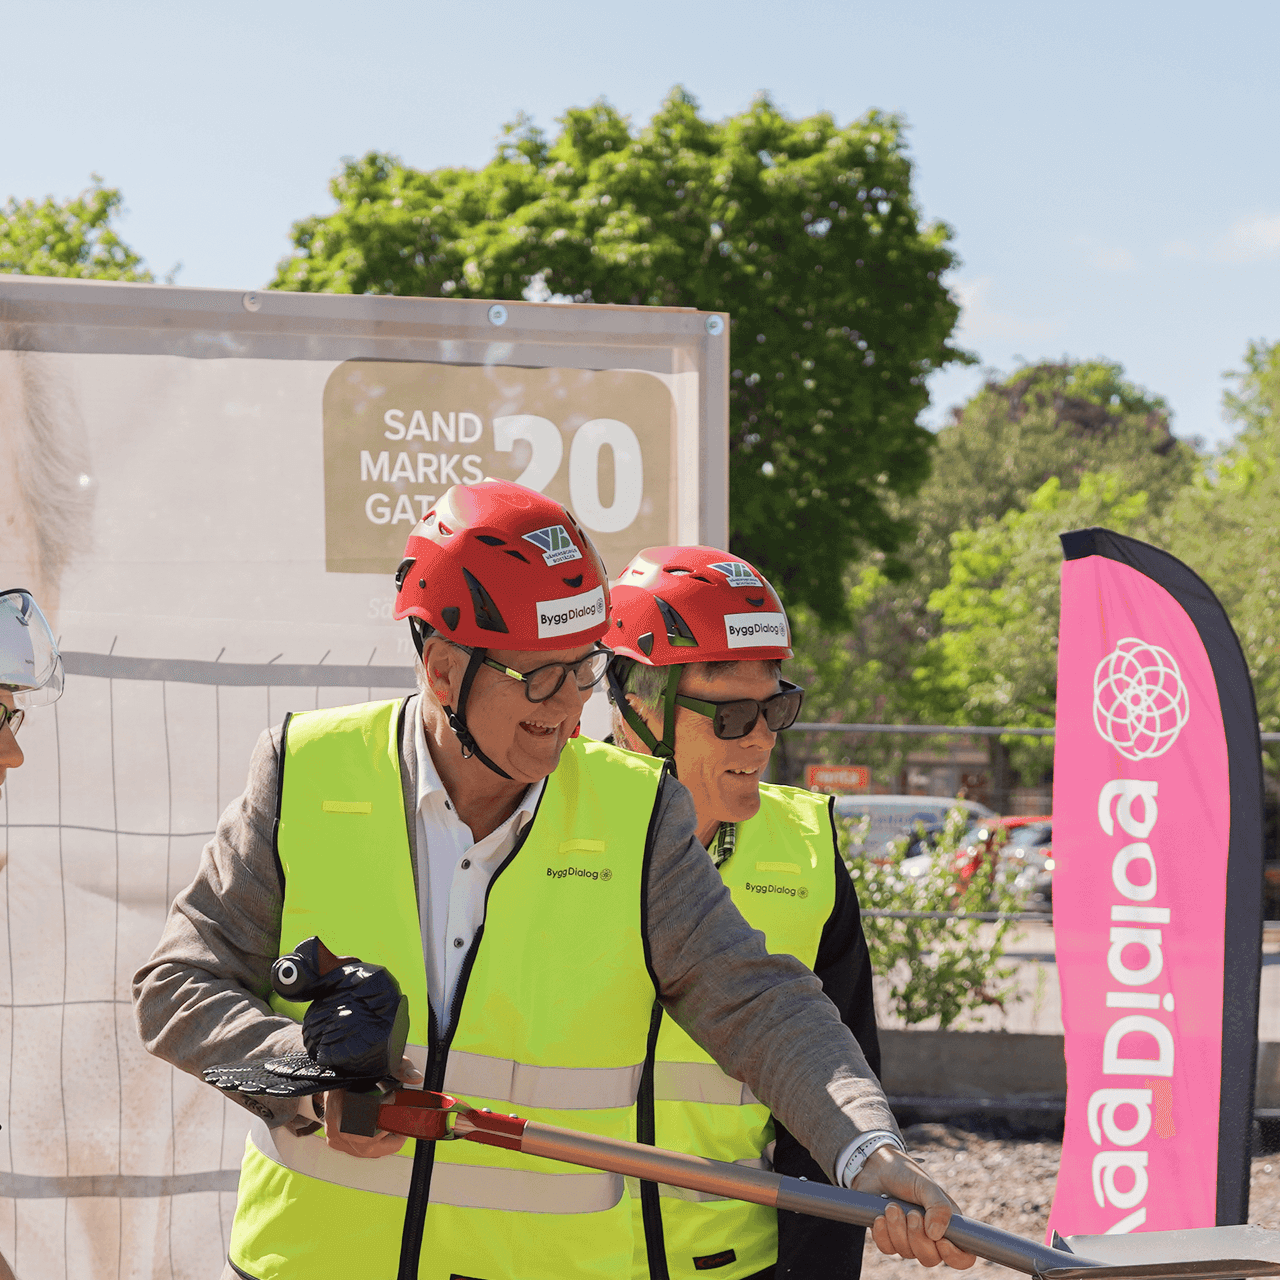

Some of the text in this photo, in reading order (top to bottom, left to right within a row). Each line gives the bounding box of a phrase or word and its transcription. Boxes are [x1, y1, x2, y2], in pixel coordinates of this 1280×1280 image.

[383, 408, 483, 443] SAND
[359, 450, 484, 485] MARKS
[493, 413, 644, 533] 20
[540, 604, 596, 626] ByggDialog
[728, 623, 779, 637] ByggDialog
[546, 866, 599, 881] ByggDialog
[745, 881, 797, 897] ByggDialog
